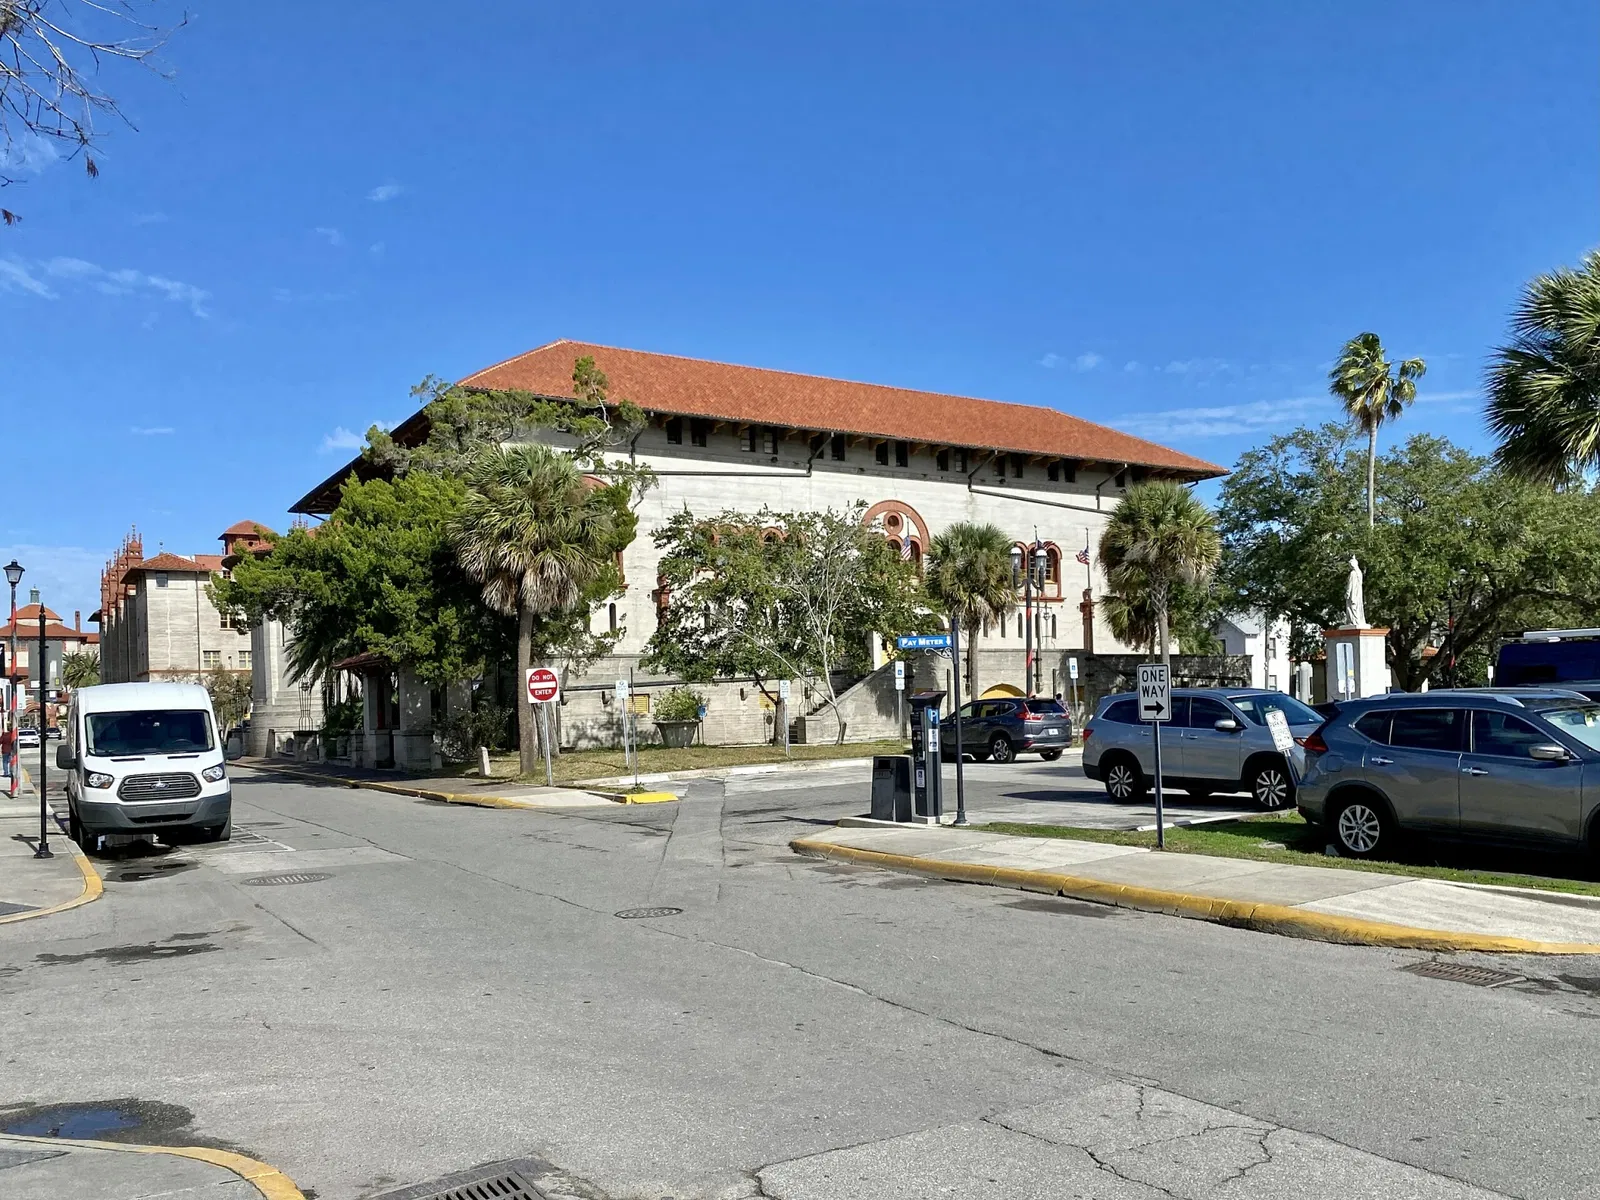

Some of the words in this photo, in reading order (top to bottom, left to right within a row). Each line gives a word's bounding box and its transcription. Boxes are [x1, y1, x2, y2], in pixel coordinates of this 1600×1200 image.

[1142, 670, 1165, 682] ONE
[1142, 685, 1165, 698] WAY
[930, 710, 938, 722] P
